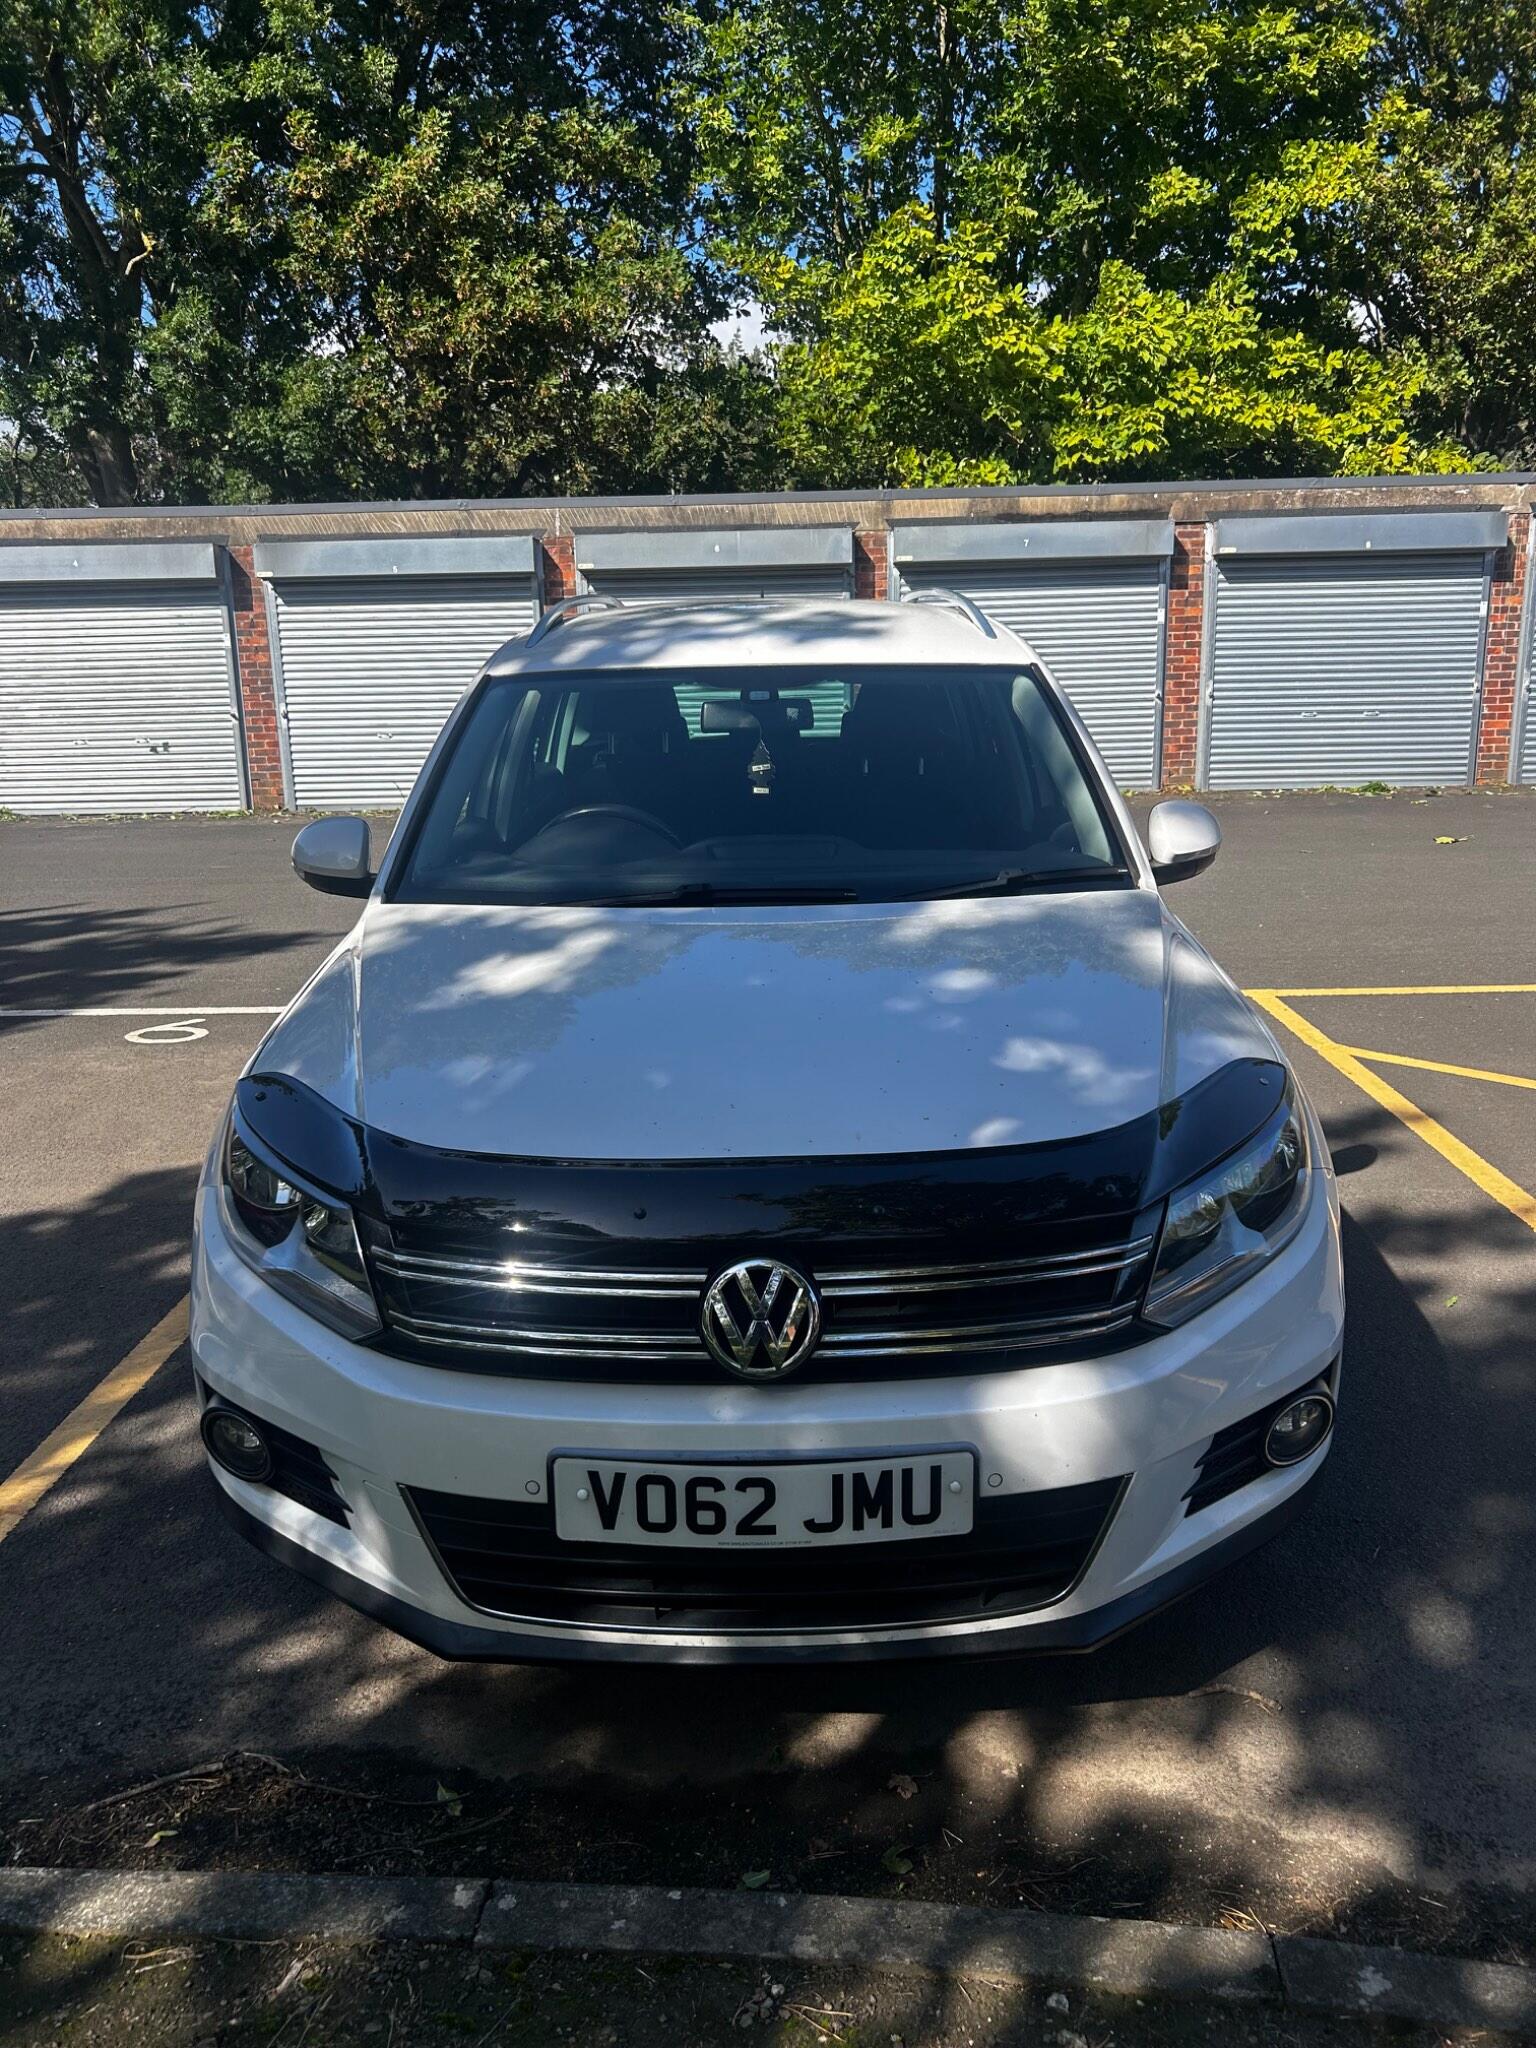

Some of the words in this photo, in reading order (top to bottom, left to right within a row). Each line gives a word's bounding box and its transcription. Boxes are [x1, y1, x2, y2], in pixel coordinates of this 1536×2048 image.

[124, 1017, 210, 1044] 6
[586, 1469, 777, 1536] VO62
[803, 1464, 943, 1533] JMU
